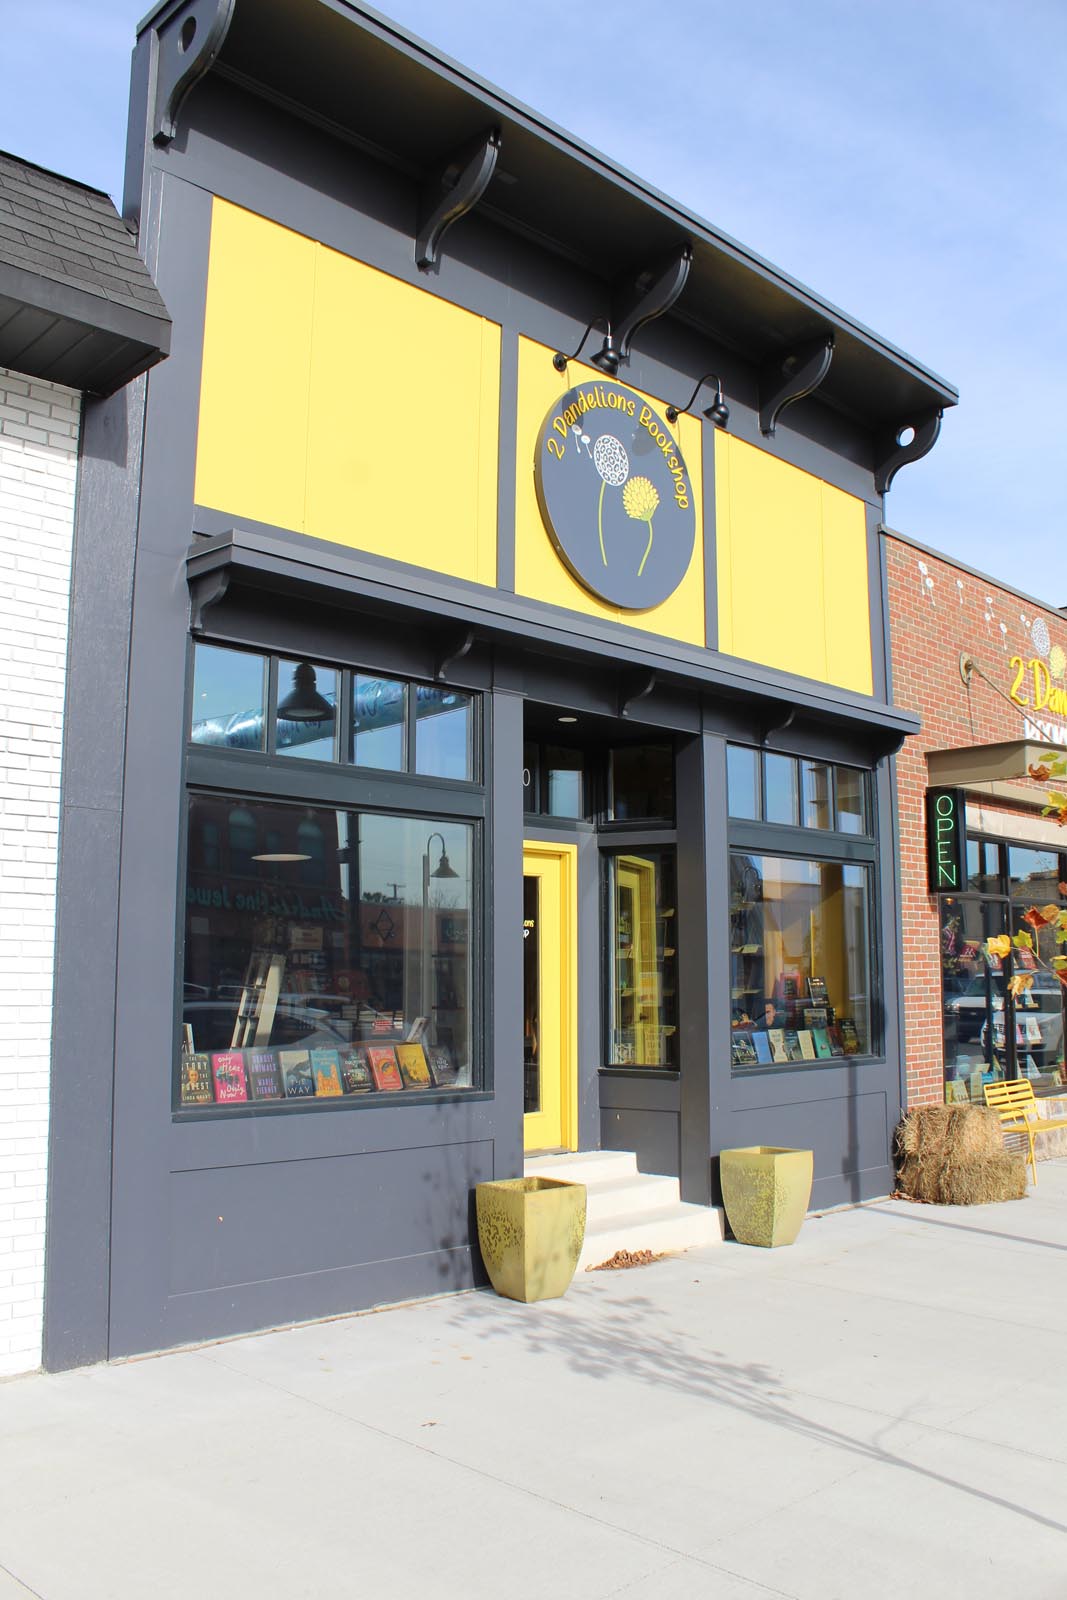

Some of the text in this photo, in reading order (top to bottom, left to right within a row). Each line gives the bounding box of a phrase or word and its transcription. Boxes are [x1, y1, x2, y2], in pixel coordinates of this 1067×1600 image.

[547, 385, 689, 509] 2 Dandelions Bookshop
[1009, 656, 1029, 706] 2
[936, 795, 957, 887] OPEN
[181, 1061, 207, 1071] TORY
[288, 1086, 310, 1095] WAY
